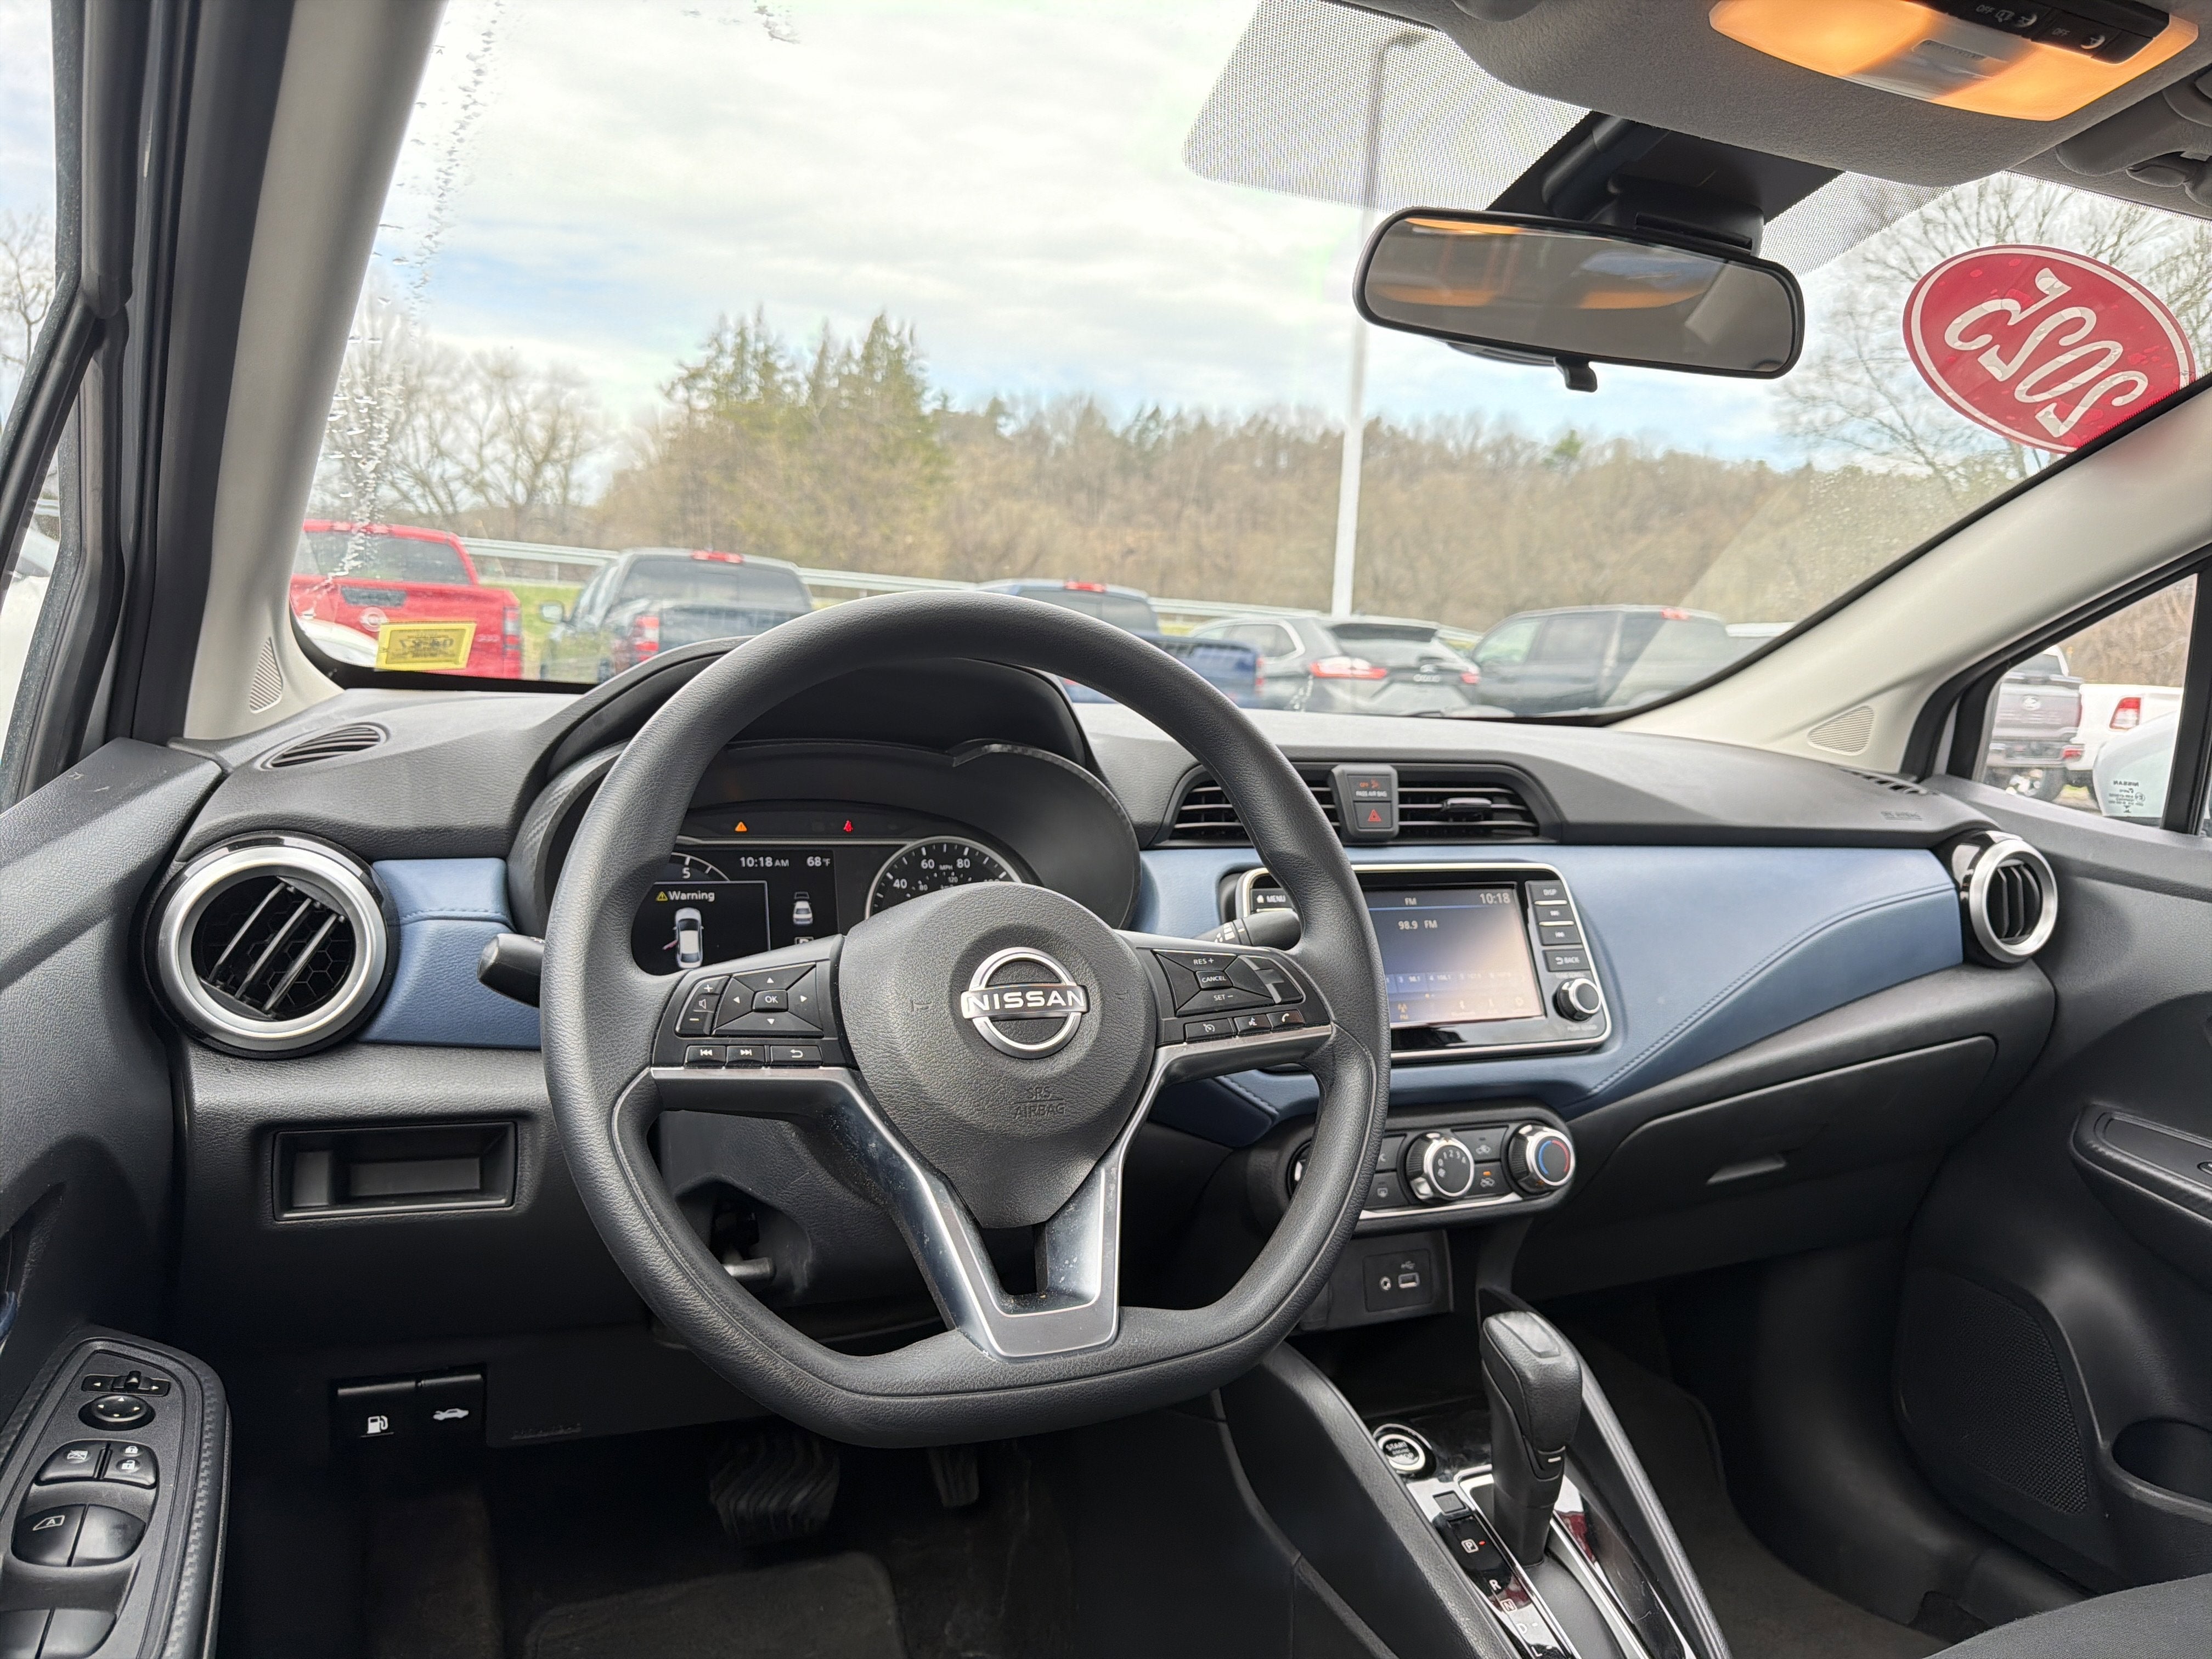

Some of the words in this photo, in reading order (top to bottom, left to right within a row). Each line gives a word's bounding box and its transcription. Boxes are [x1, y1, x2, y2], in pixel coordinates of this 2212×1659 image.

[1976, 4, 1995, 14] OFF
[2052, 27, 2071, 36] OFF
[740, 856, 773, 867] 10:18
[774, 859, 789, 867] AM
[921, 859, 935, 870] 60
[956, 858, 970, 869] 80
[682, 867, 691, 879] 5
[893, 878, 907, 889] 40
[668, 890, 715, 902] Warning
[1266, 895, 1286, 903] MENU
[1480, 893, 1510, 904] 10:18
[1398, 920, 1418, 929] 98.9
[1424, 920, 1438, 928] FM
[765, 995, 778, 1003] OK
[968, 990, 1085, 1011] NISSAN
[1465, 1541, 1474, 1551] P
[1489, 1579, 1501, 1591] R
[1504, 1601, 1515, 1610] N
[1516, 1623, 1527, 1634] D
[1531, 1646, 1543, 1657] L
